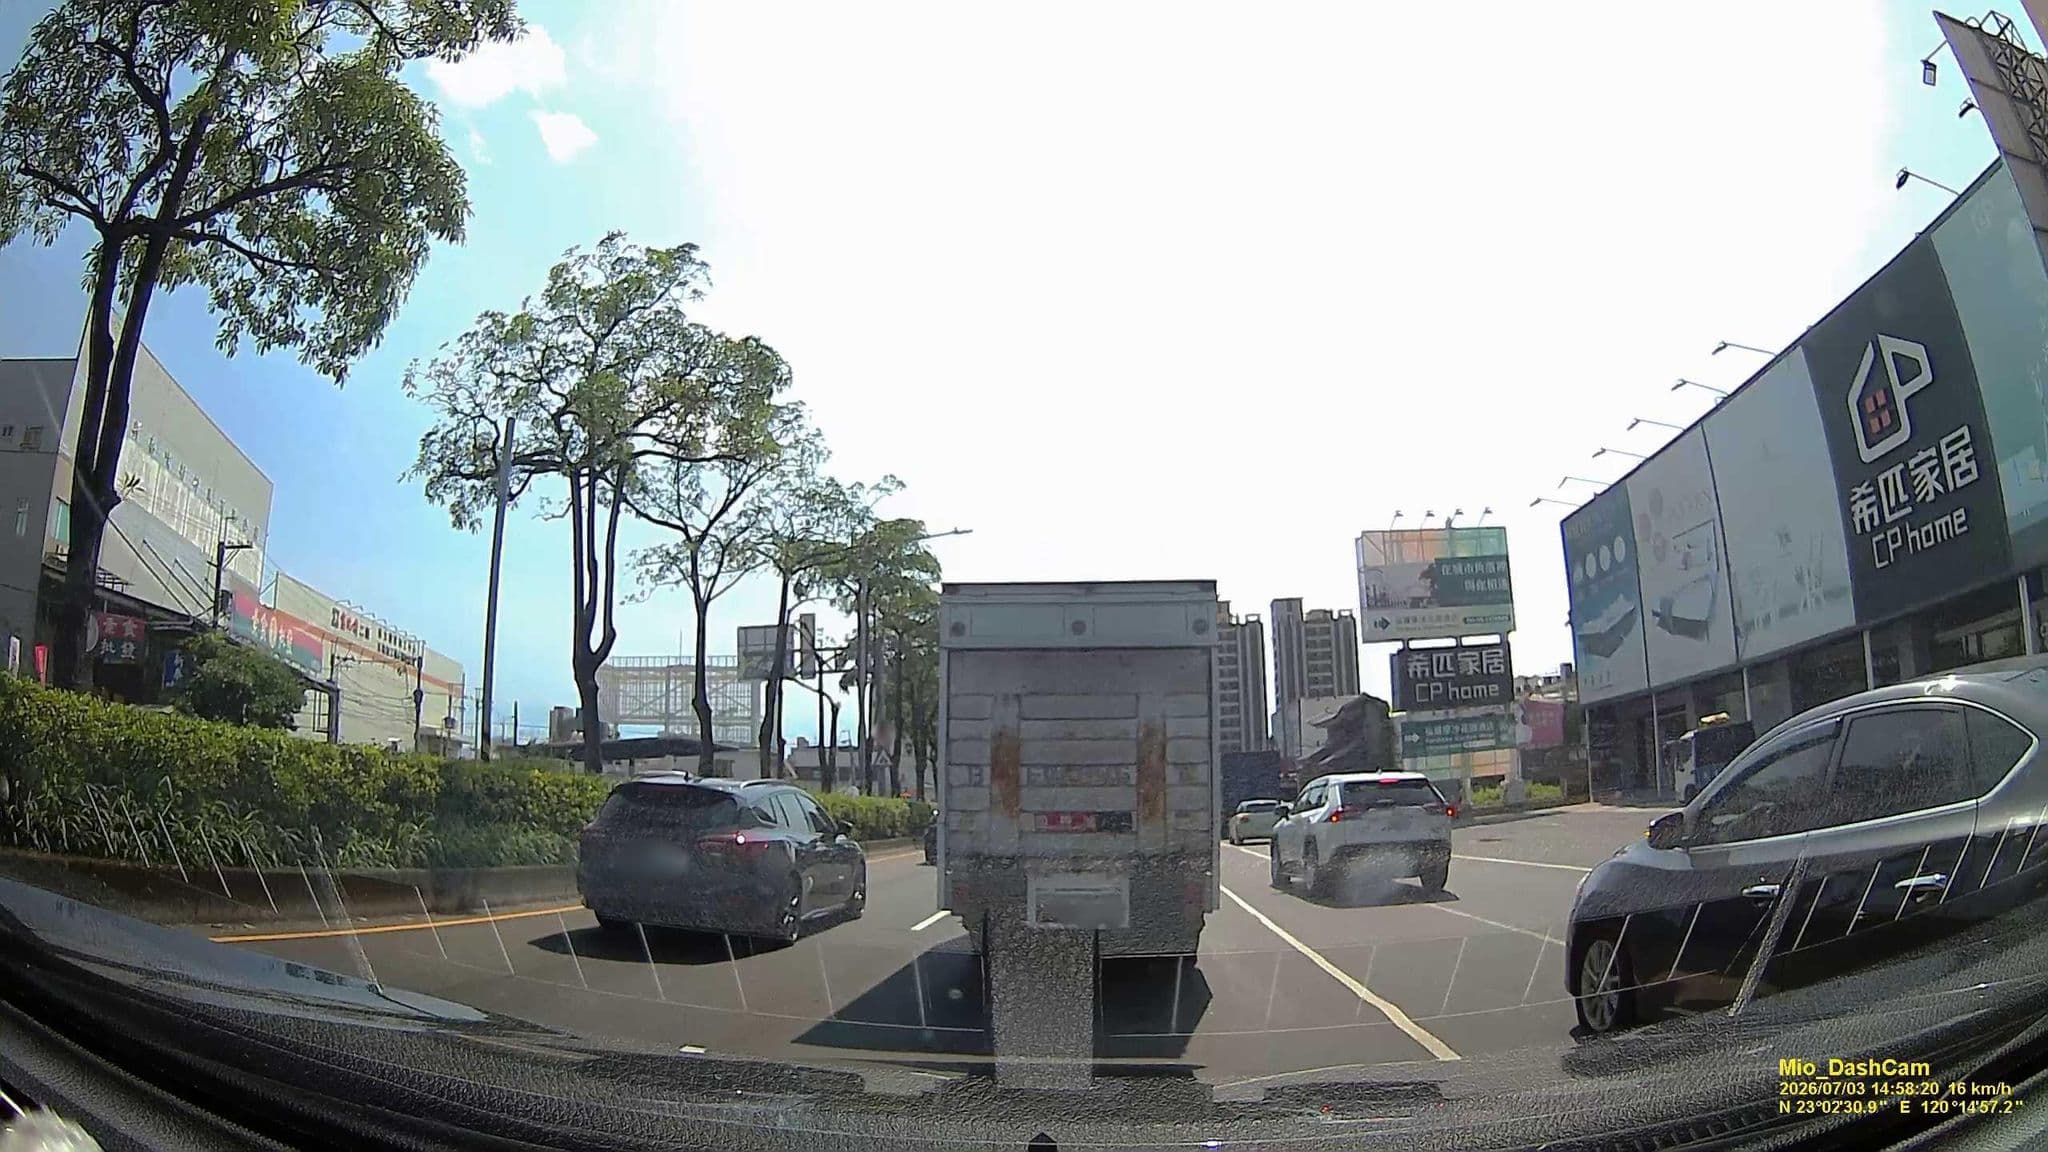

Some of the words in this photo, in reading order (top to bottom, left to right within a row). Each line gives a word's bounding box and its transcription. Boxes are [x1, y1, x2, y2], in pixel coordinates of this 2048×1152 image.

[1850, 424, 1979, 535] 希匹家居
[1872, 525, 1903, 569] CP
[1905, 507, 1969, 555] home
[1407, 648, 1505, 679] 希匹家居
[1415, 682, 1443, 702] CP
[1447, 681, 1500, 701] home
